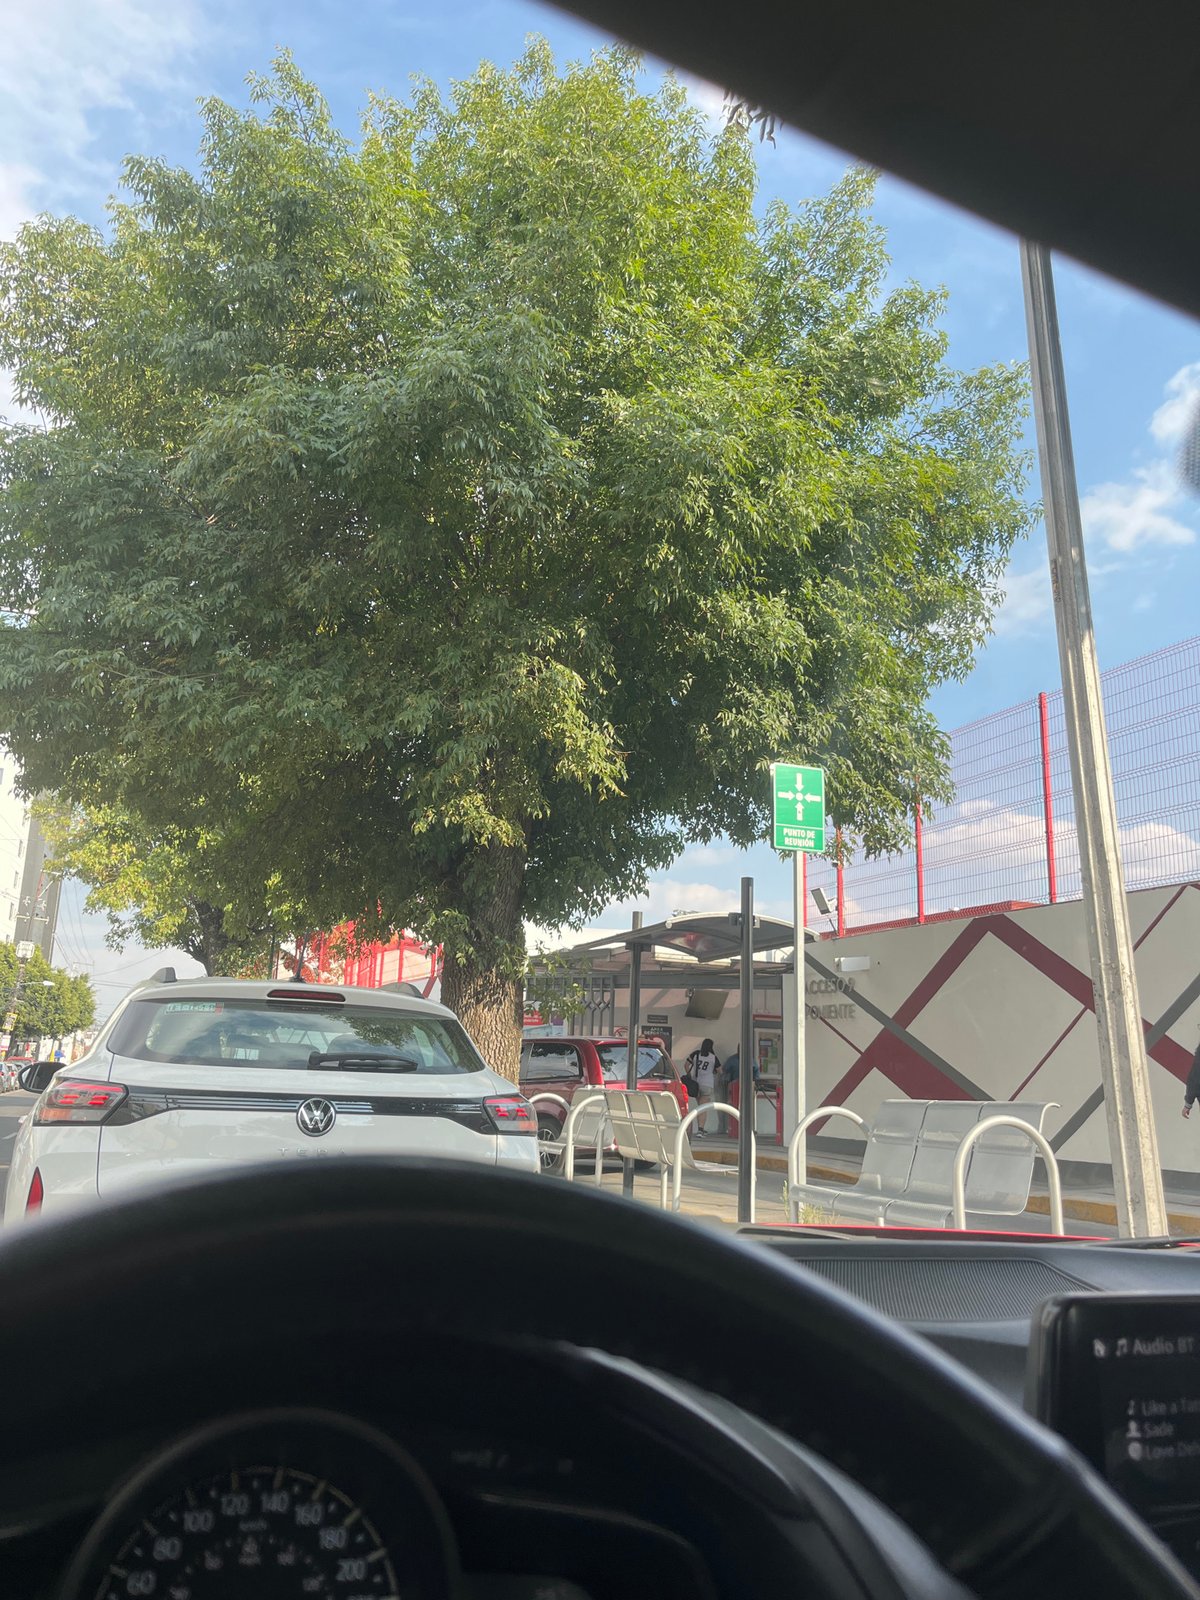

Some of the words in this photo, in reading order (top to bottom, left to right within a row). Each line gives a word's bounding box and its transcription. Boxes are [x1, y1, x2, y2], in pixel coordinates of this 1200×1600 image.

[783, 827, 806, 838] PUNTO
[806, 830, 815, 839] DE
[697, 1060, 709, 1071] 28
[1133, 1337, 1174, 1355] Audio
[1177, 1336, 1195, 1354] BT
